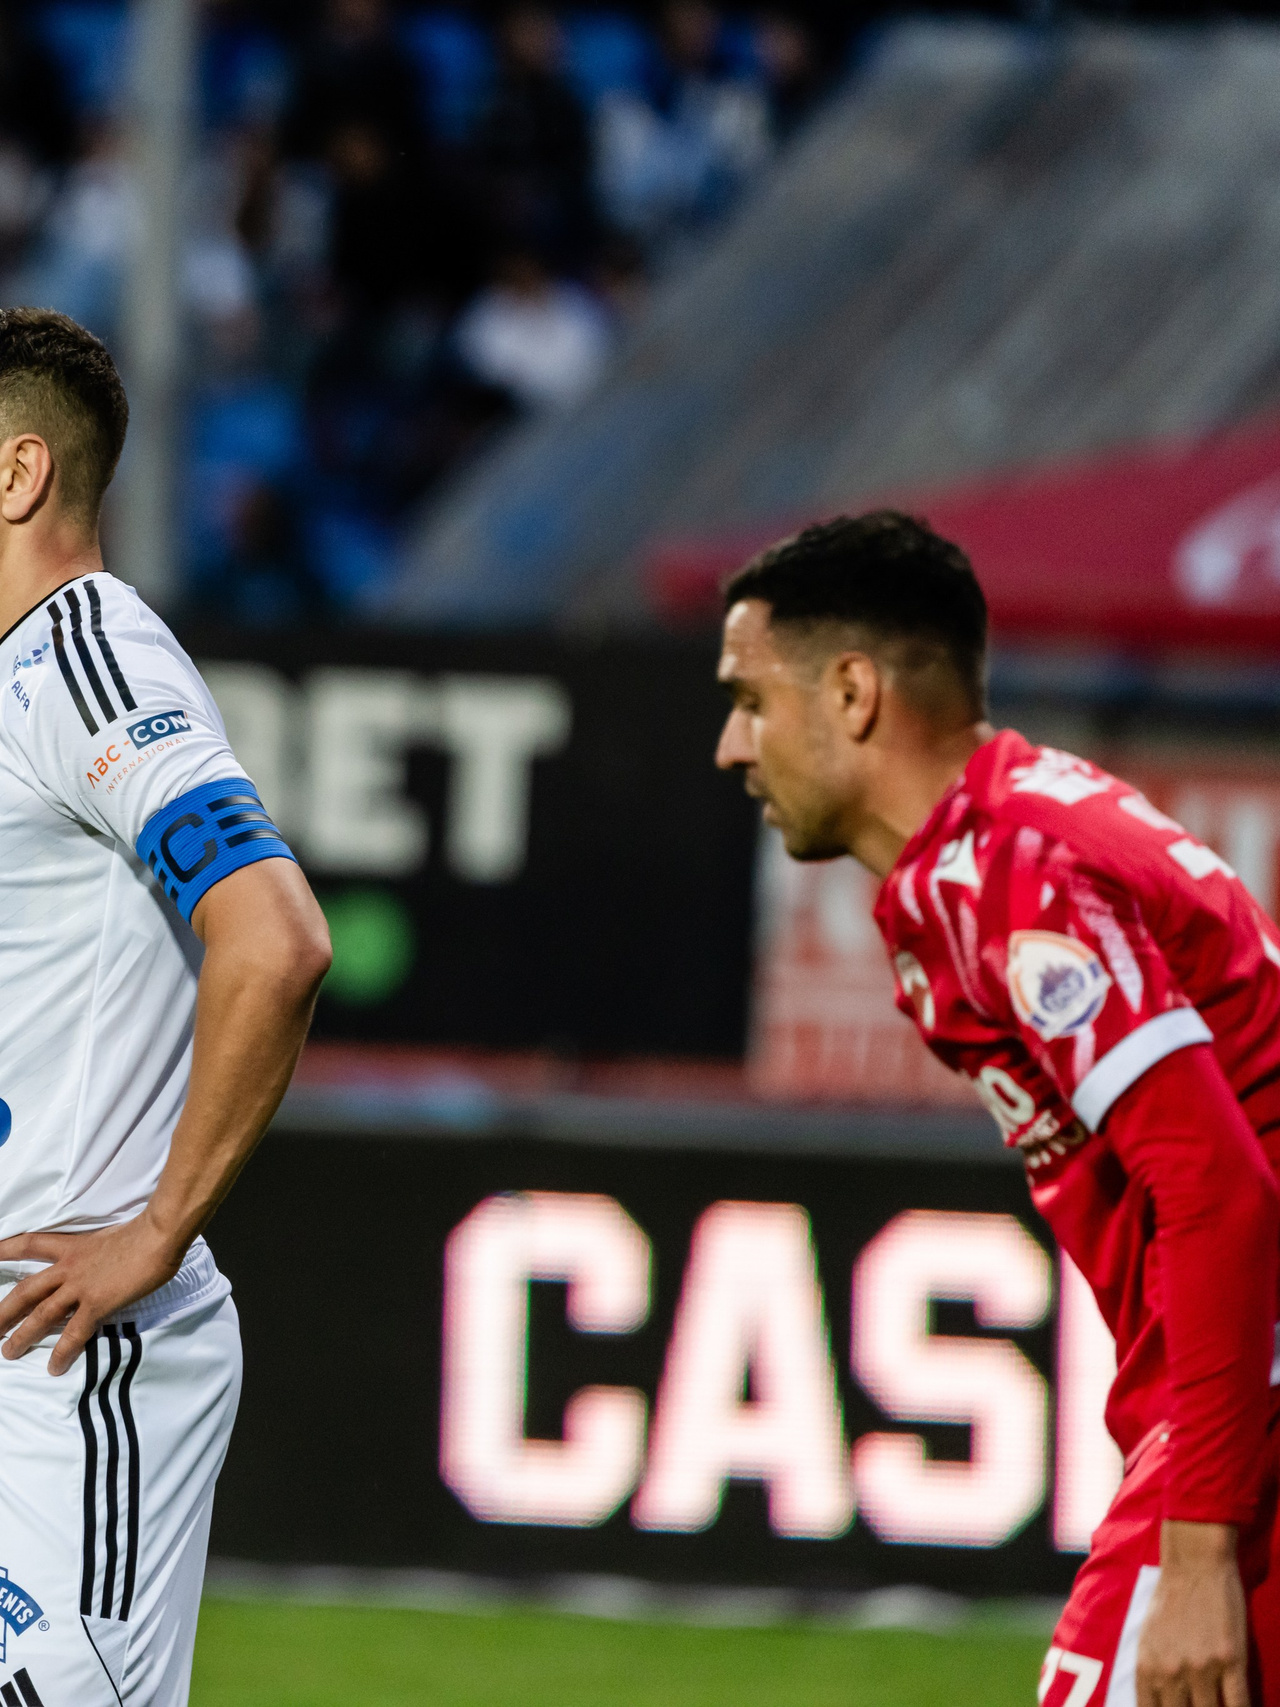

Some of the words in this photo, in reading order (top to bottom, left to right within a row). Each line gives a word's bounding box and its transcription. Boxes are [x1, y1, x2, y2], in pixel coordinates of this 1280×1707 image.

[11, 681, 30, 712] ALFA
[106, 737, 187, 795] INTERNATIONAL
[160, 812, 218, 884] C
